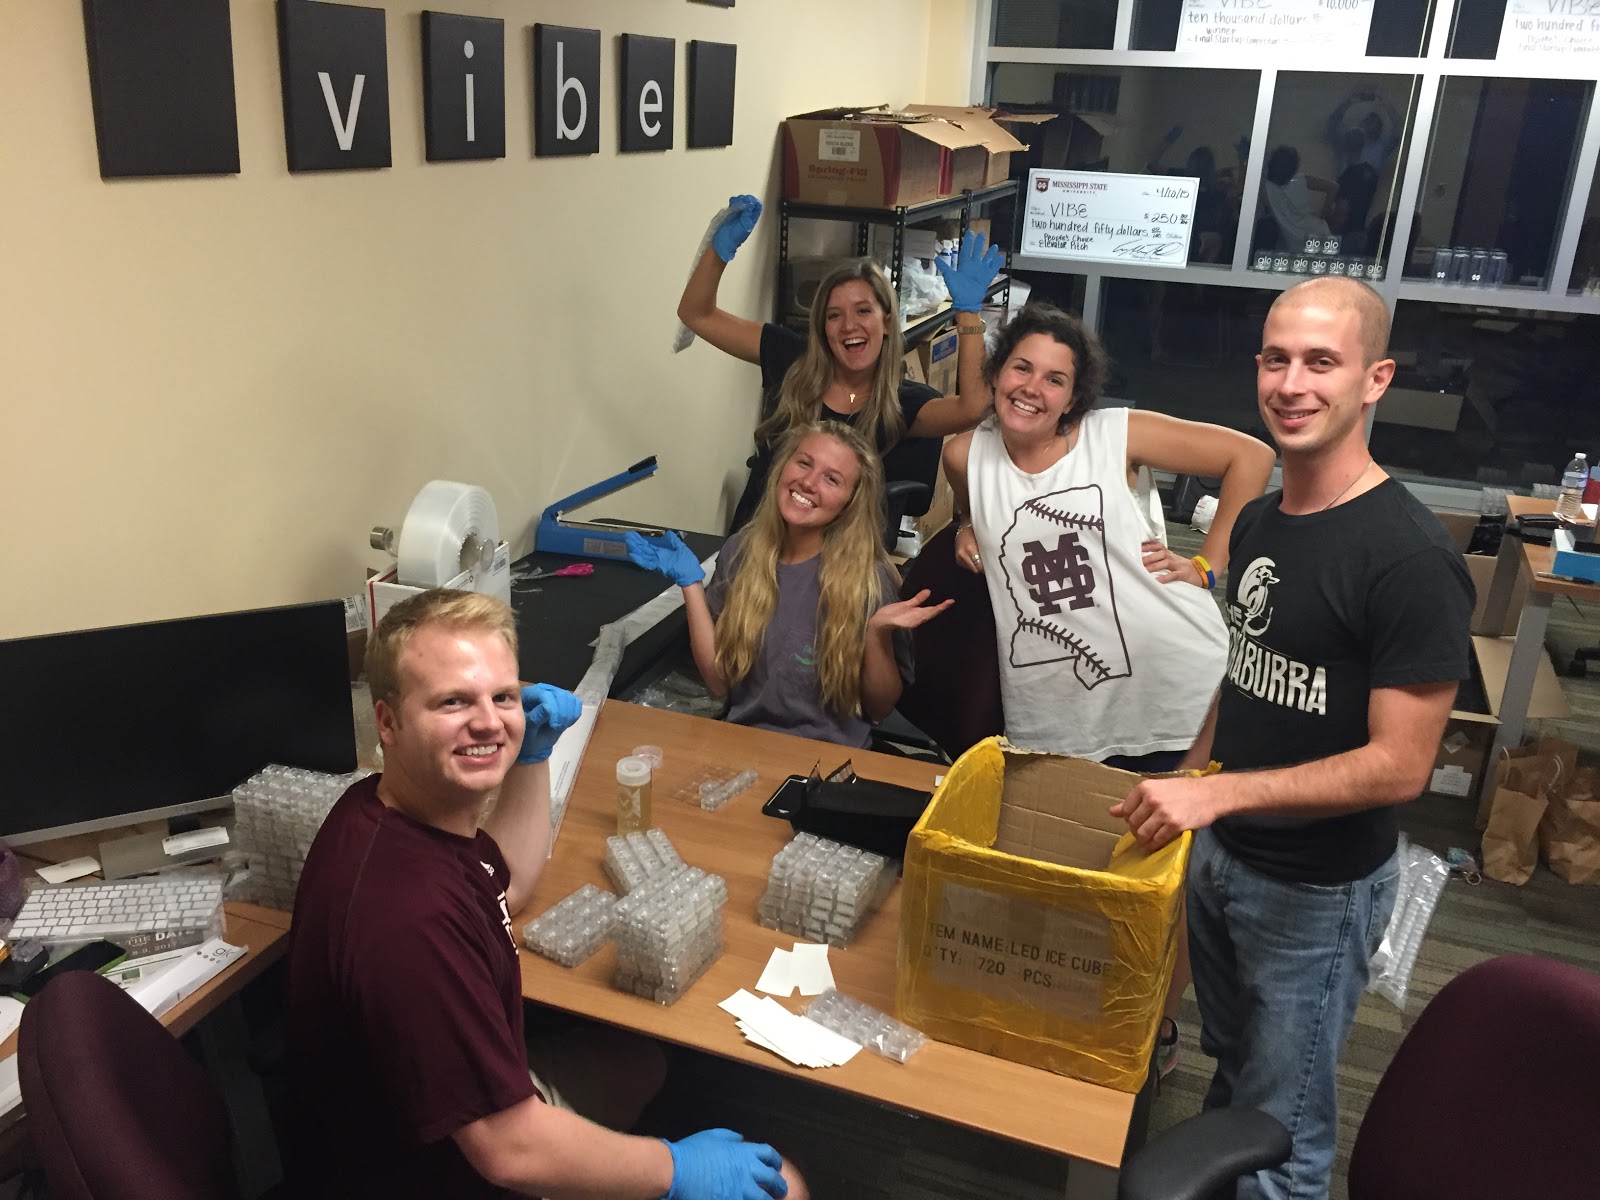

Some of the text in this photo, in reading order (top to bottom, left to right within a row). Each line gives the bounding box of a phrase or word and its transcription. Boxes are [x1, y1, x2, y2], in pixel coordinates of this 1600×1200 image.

[1188, 11, 1209, 23] ten
[1214, 11, 1266, 25] thousand
[1537, 18, 1584, 32] hundred
[1052, 181, 1108, 191] MISSISSIPPI STATE
[1151, 212, 1178, 224] 250
[1031, 218, 1048, 229] two
[1049, 219, 1089, 233] hundred
[1094, 222, 1115, 240] fifty
[1116, 225, 1149, 236] dollars
[1072, 234, 1094, 243] Choice
[1070, 240, 1089, 250] Pitch
[1305, 239, 1321, 249] glo
[1323, 240, 1339, 249] glo
[1257, 256, 1272, 265] glo
[1273, 257, 1289, 266] glo
[1293, 258, 1308, 267] glo
[1311, 260, 1327, 269] glo
[1329, 261, 1345, 270] glo
[1348, 262, 1363, 271] glo
[1367, 264, 1383, 273] glo
[1045, 949, 1067, 967] ICE
[978, 956, 1005, 976] 720
[1023, 968, 1052, 988] PCS
